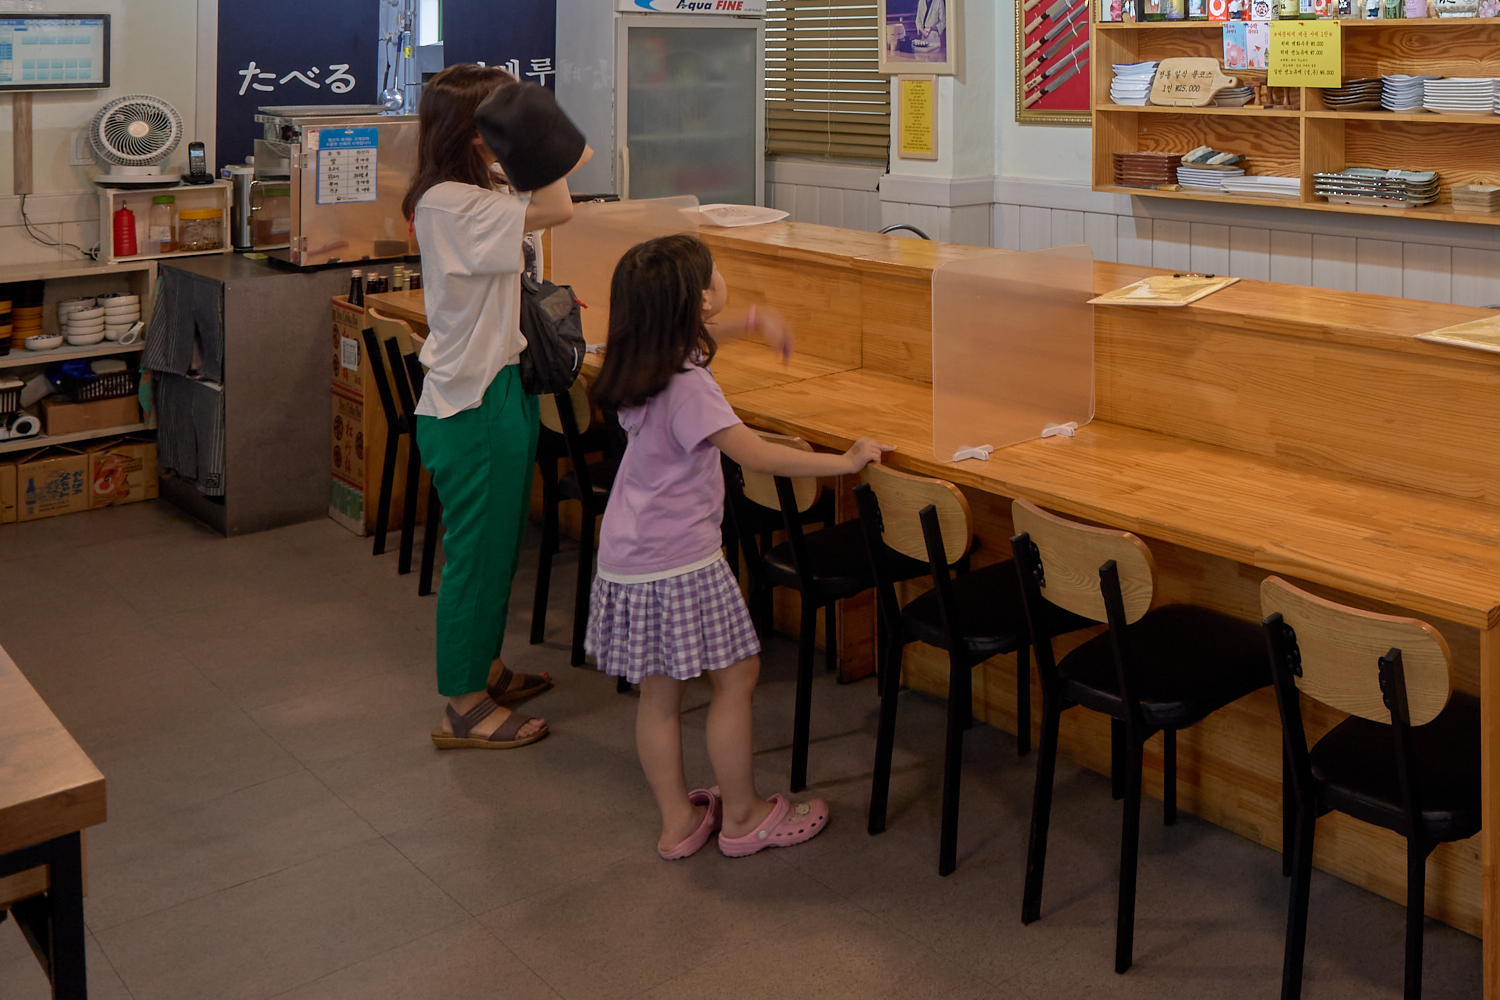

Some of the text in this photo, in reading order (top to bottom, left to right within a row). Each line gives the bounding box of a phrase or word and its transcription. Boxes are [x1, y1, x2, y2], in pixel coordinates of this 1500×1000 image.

[676, 0, 743, 11] Aqua FINE
[238, 61, 356, 95] たべる
